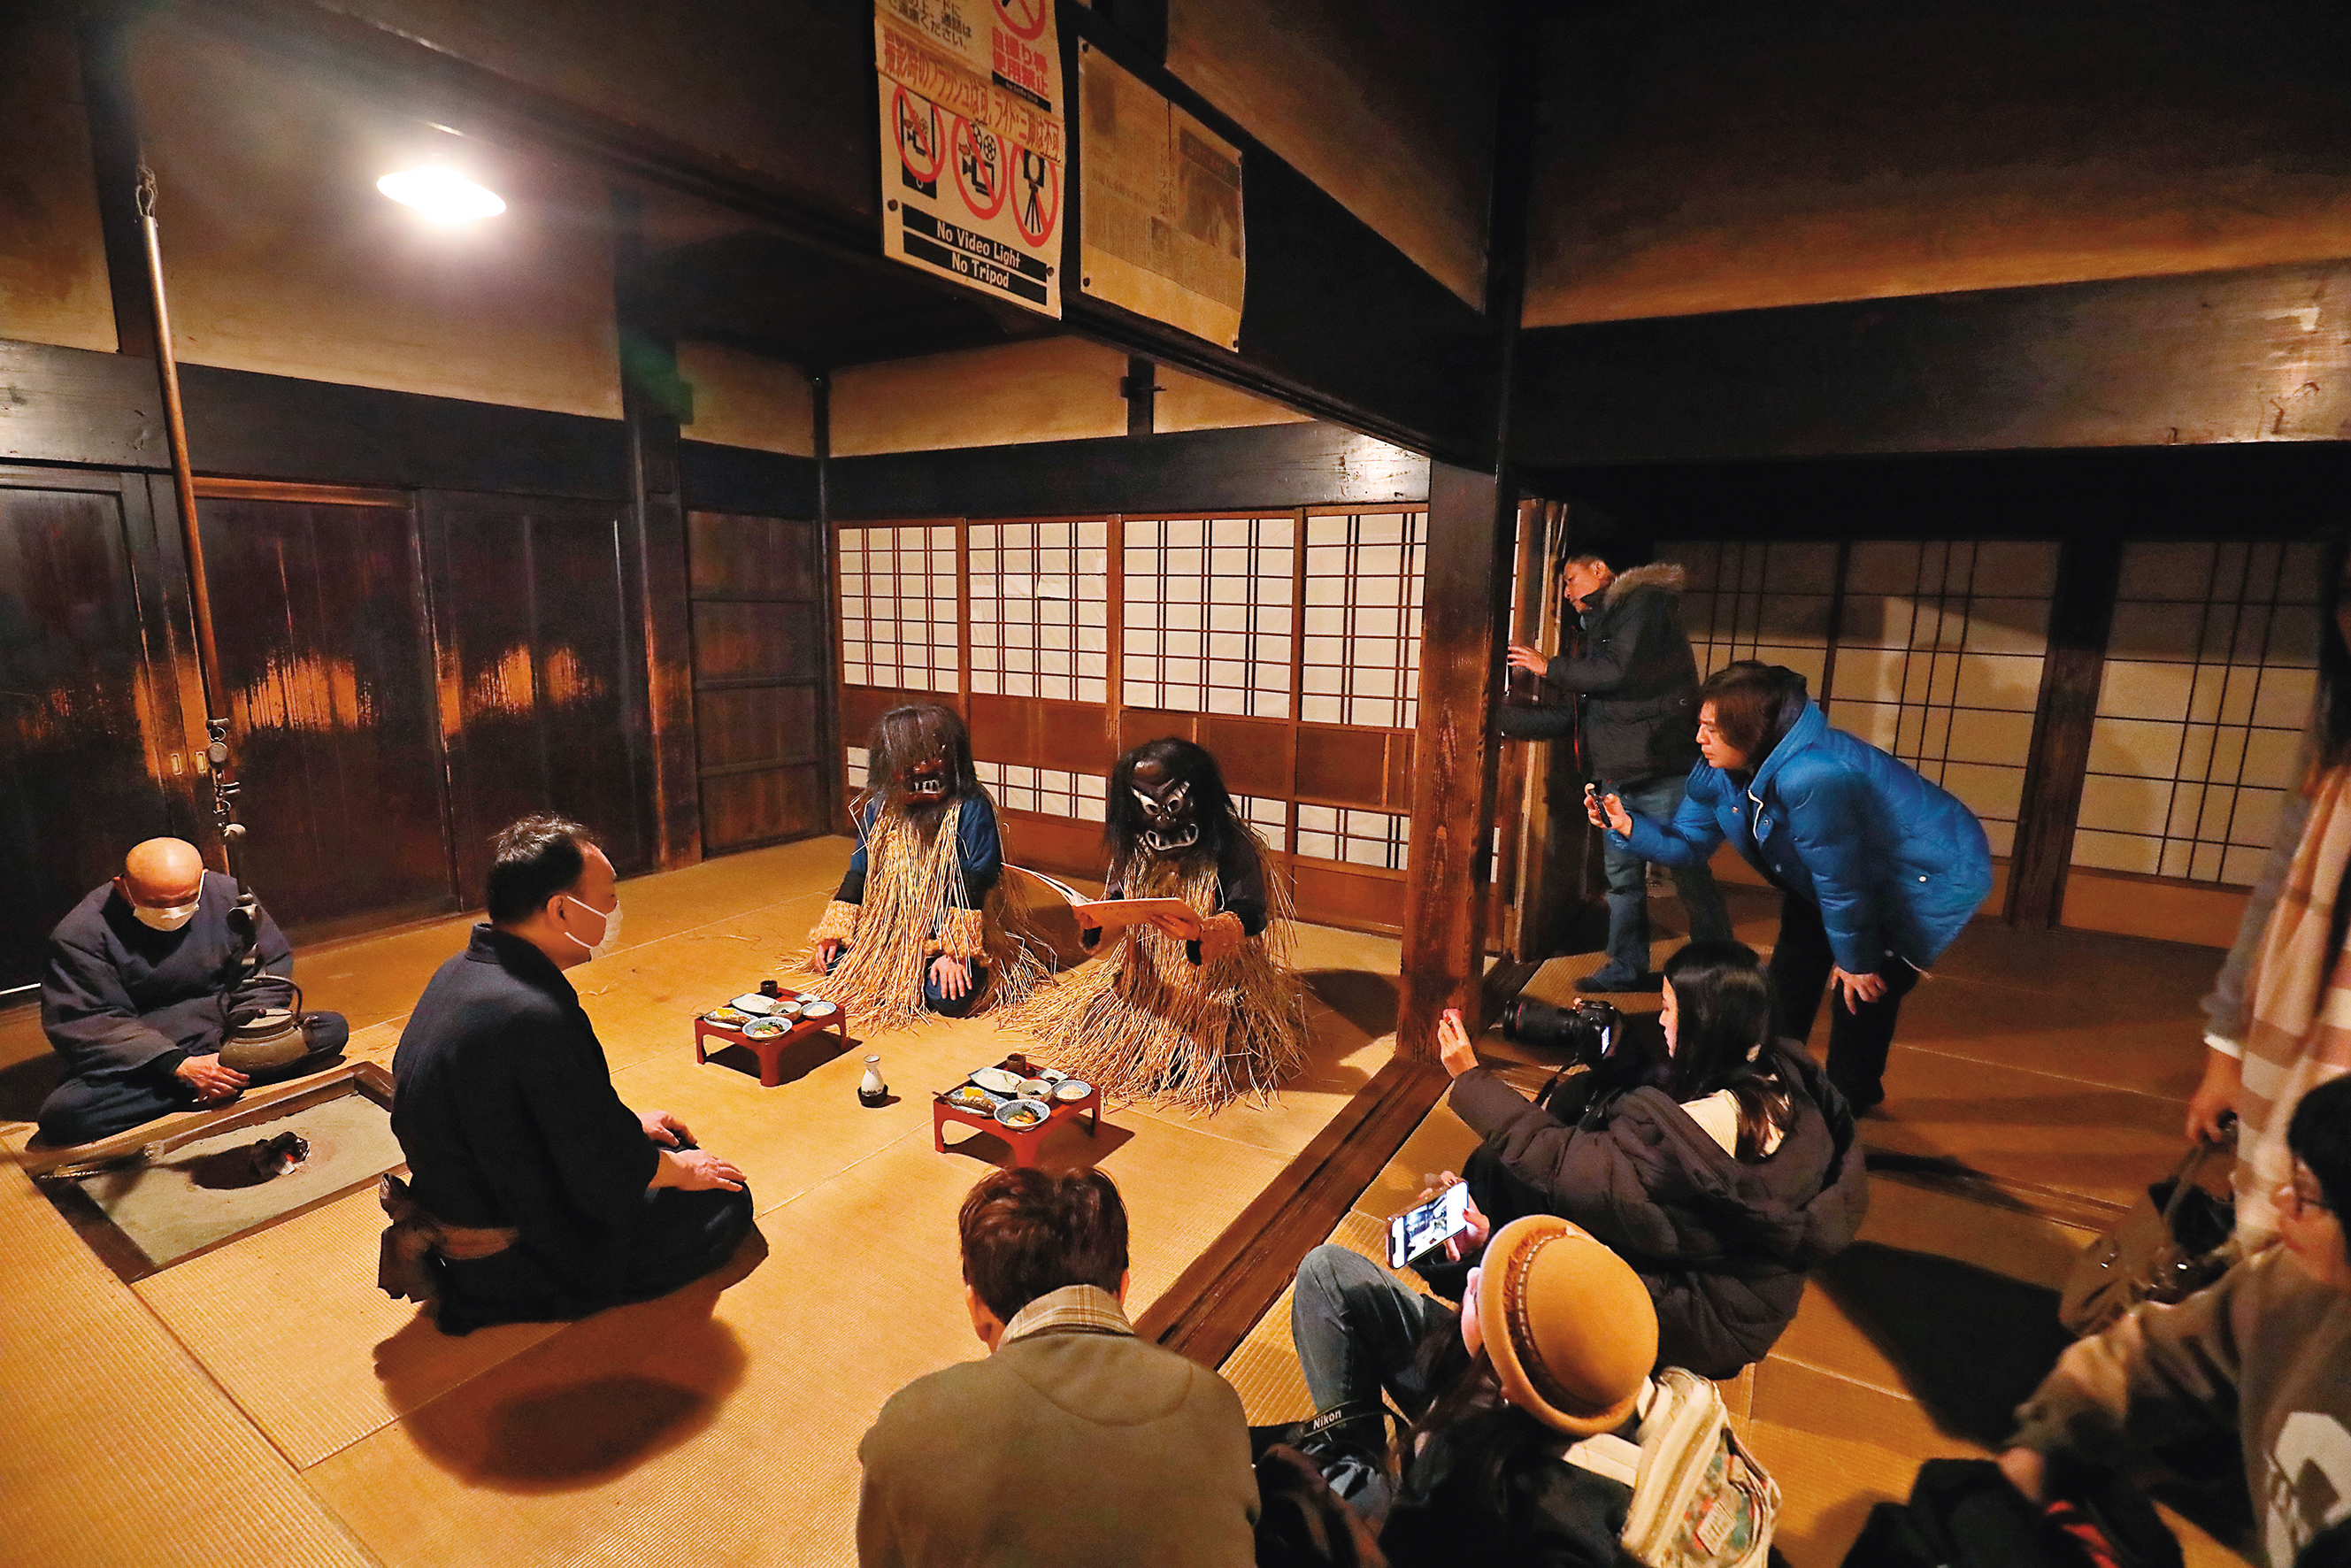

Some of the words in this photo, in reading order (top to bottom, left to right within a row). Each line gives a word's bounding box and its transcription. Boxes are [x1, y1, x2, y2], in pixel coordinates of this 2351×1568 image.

[994, 49, 1049, 99] 使用禁止
[937, 219, 953, 242] No
[957, 228, 990, 256] Video
[994, 242, 1020, 268] Light
[951, 251, 968, 273] No
[972, 258, 1009, 288] Tripod
[1313, 1410, 1342, 1430] Nikon
